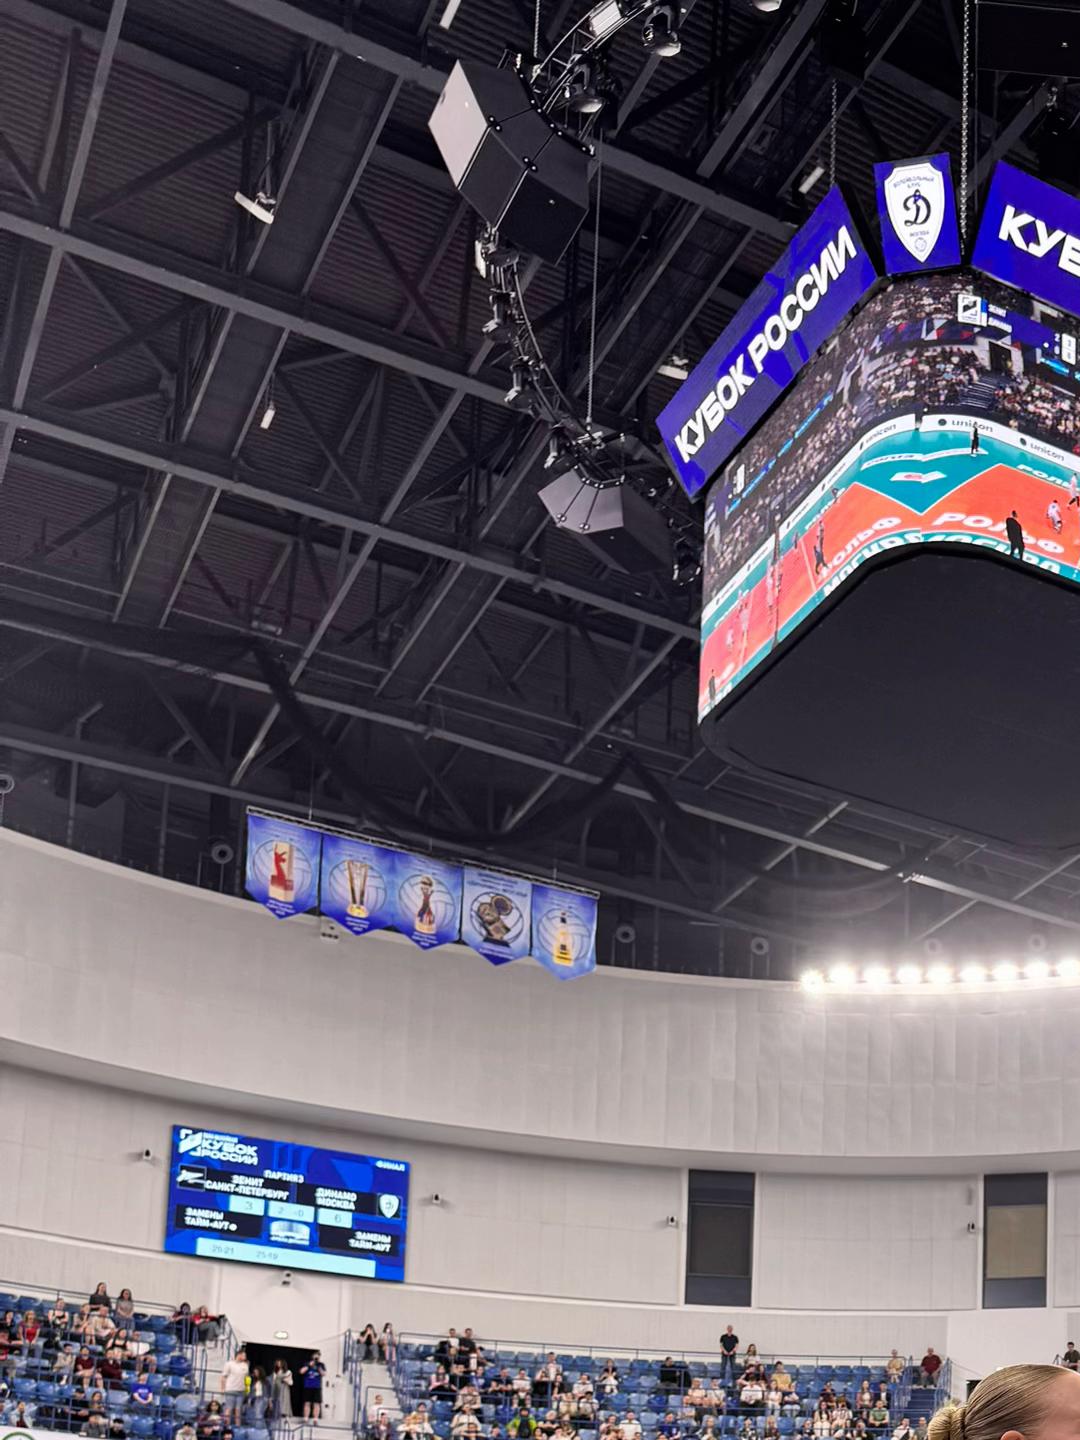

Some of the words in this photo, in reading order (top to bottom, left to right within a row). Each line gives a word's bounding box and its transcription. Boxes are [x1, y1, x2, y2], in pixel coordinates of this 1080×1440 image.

[674, 363, 755, 464] КУБОК
[747, 225, 857, 374] РОССИИ
[202, 1138, 258, 1156] КУБОК
[201, 1149, 259, 1166] РОССИИ
[231, 1174, 265, 1188] ЗЕНИТ
[204, 1179, 290, 1201] САНКТ-ПЕТЕРБУРГ
[315, 1187, 358, 1202] ДИНАМО
[316, 1197, 356, 1211] МОСКВА
[185, 1207, 225, 1220] ЗАМЕНЫ
